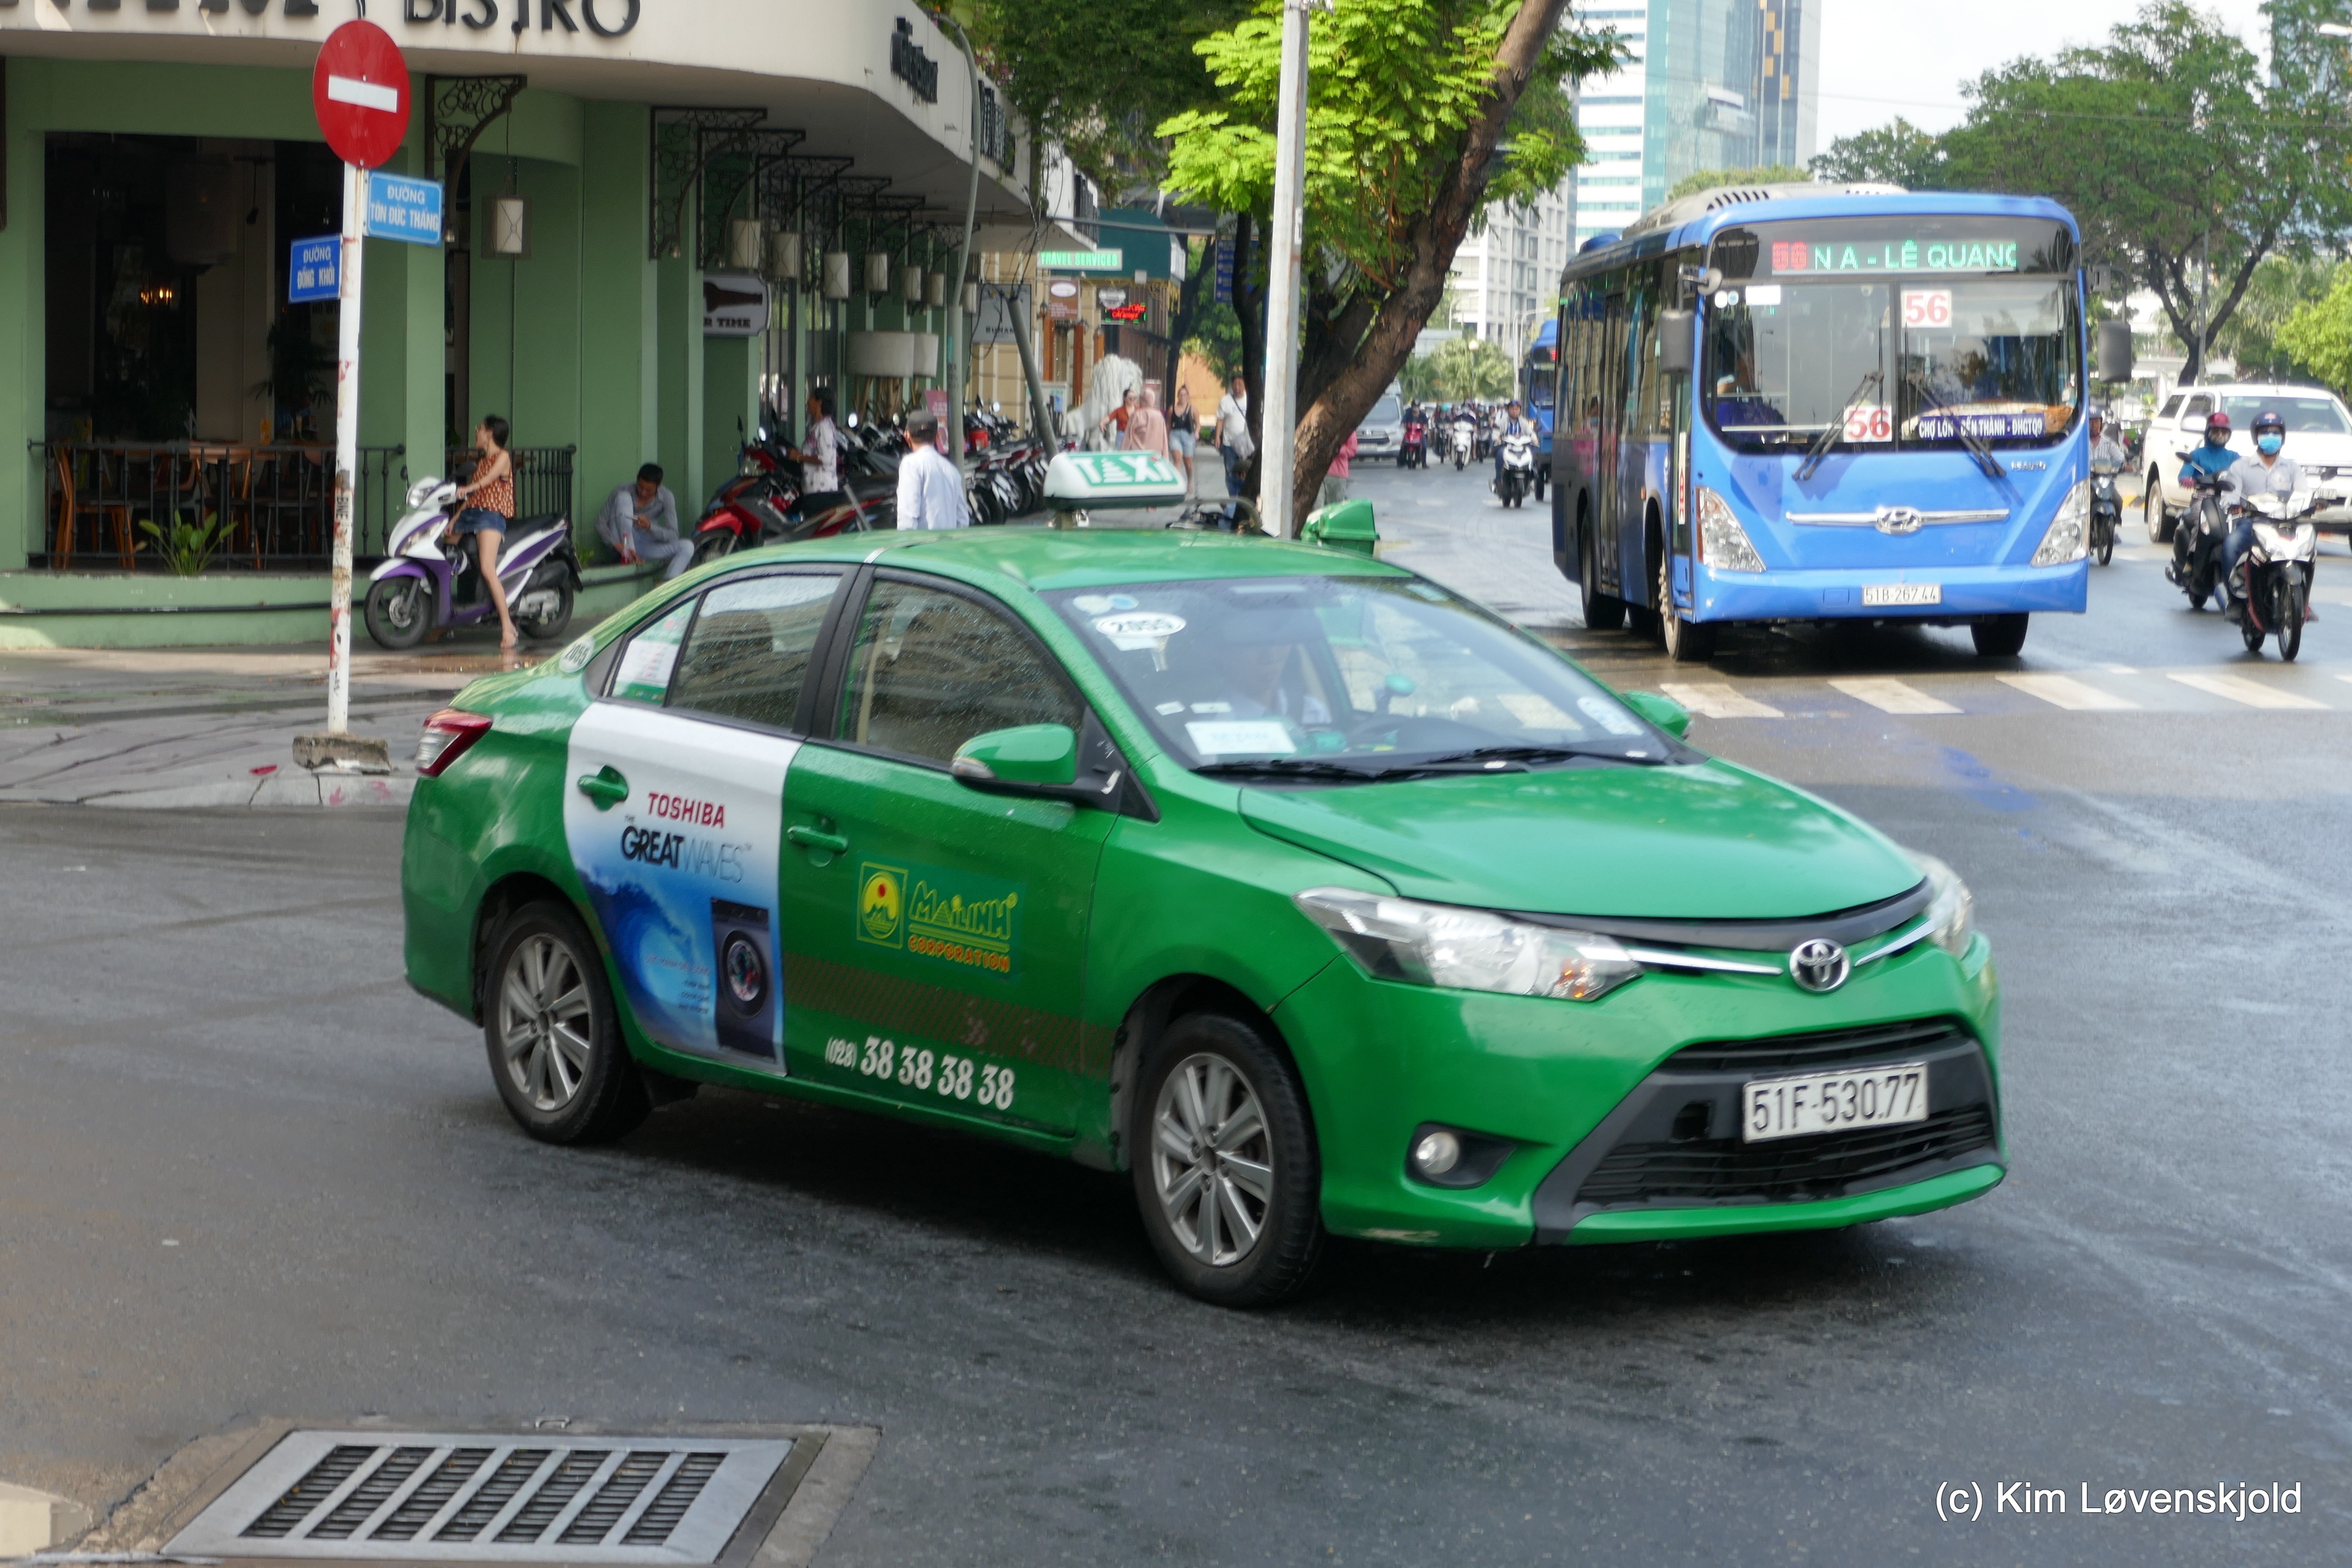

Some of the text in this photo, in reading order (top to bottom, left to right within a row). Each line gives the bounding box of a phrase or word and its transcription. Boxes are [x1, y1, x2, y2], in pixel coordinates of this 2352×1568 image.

[1074, 252, 1118, 266] SERVICES
[1773, 241, 1807, 271] 56
[717, 317, 751, 329] TIME
[1905, 294, 1948, 325] 56
[1846, 409, 1891, 440] 56
[1978, 415, 2005, 437] THÀNH
[1866, 586, 1936, 603] 51B-267.44
[647, 792, 726, 829] TOSHIBA
[621, 825, 685, 870] GREAT
[908, 935, 1010, 973] CORPORATION
[825, 1035, 1016, 1110] (028) 38 38 38 38
[1752, 1072, 1920, 1132] 51F-530.77
